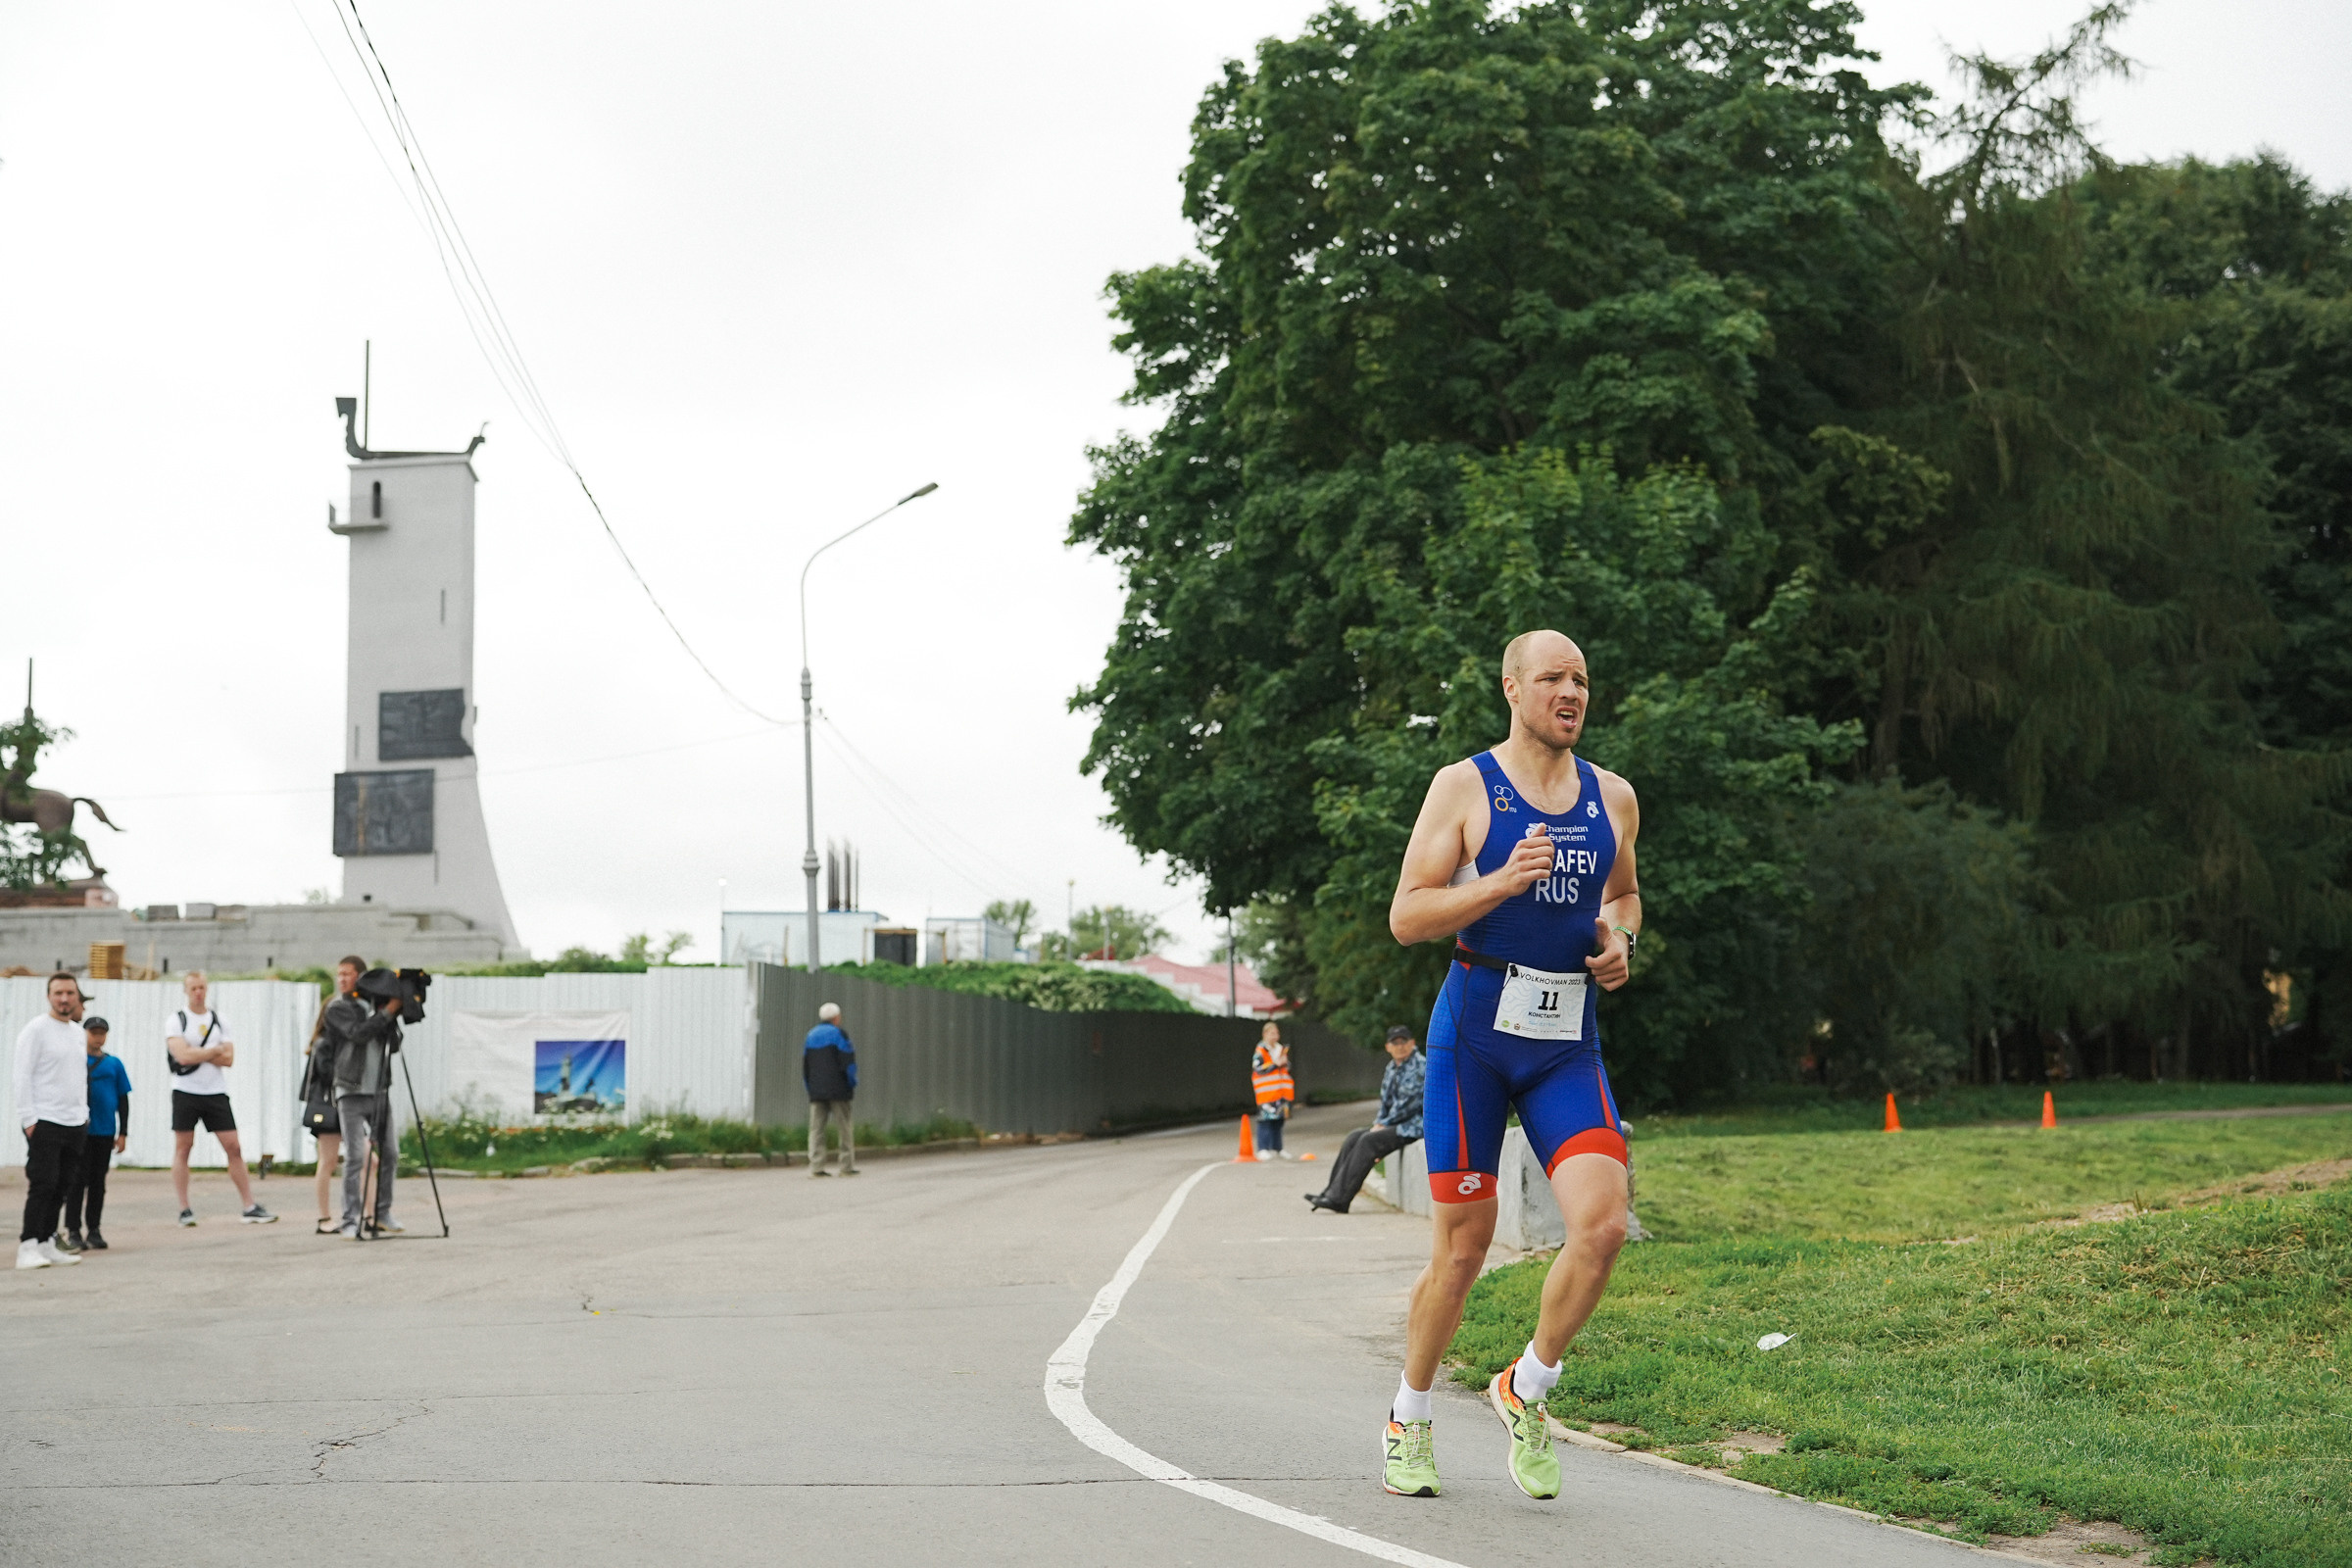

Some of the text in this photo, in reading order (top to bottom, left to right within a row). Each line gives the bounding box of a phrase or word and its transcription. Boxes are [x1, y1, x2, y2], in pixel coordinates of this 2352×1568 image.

[1548, 833, 1586, 842] System
[1550, 849, 1597, 874] AFEV
[1535, 877, 1579, 904] RUS
[1520, 972, 1568, 985] VOLKHOVMAN
[1538, 991, 1559, 1010] 11
